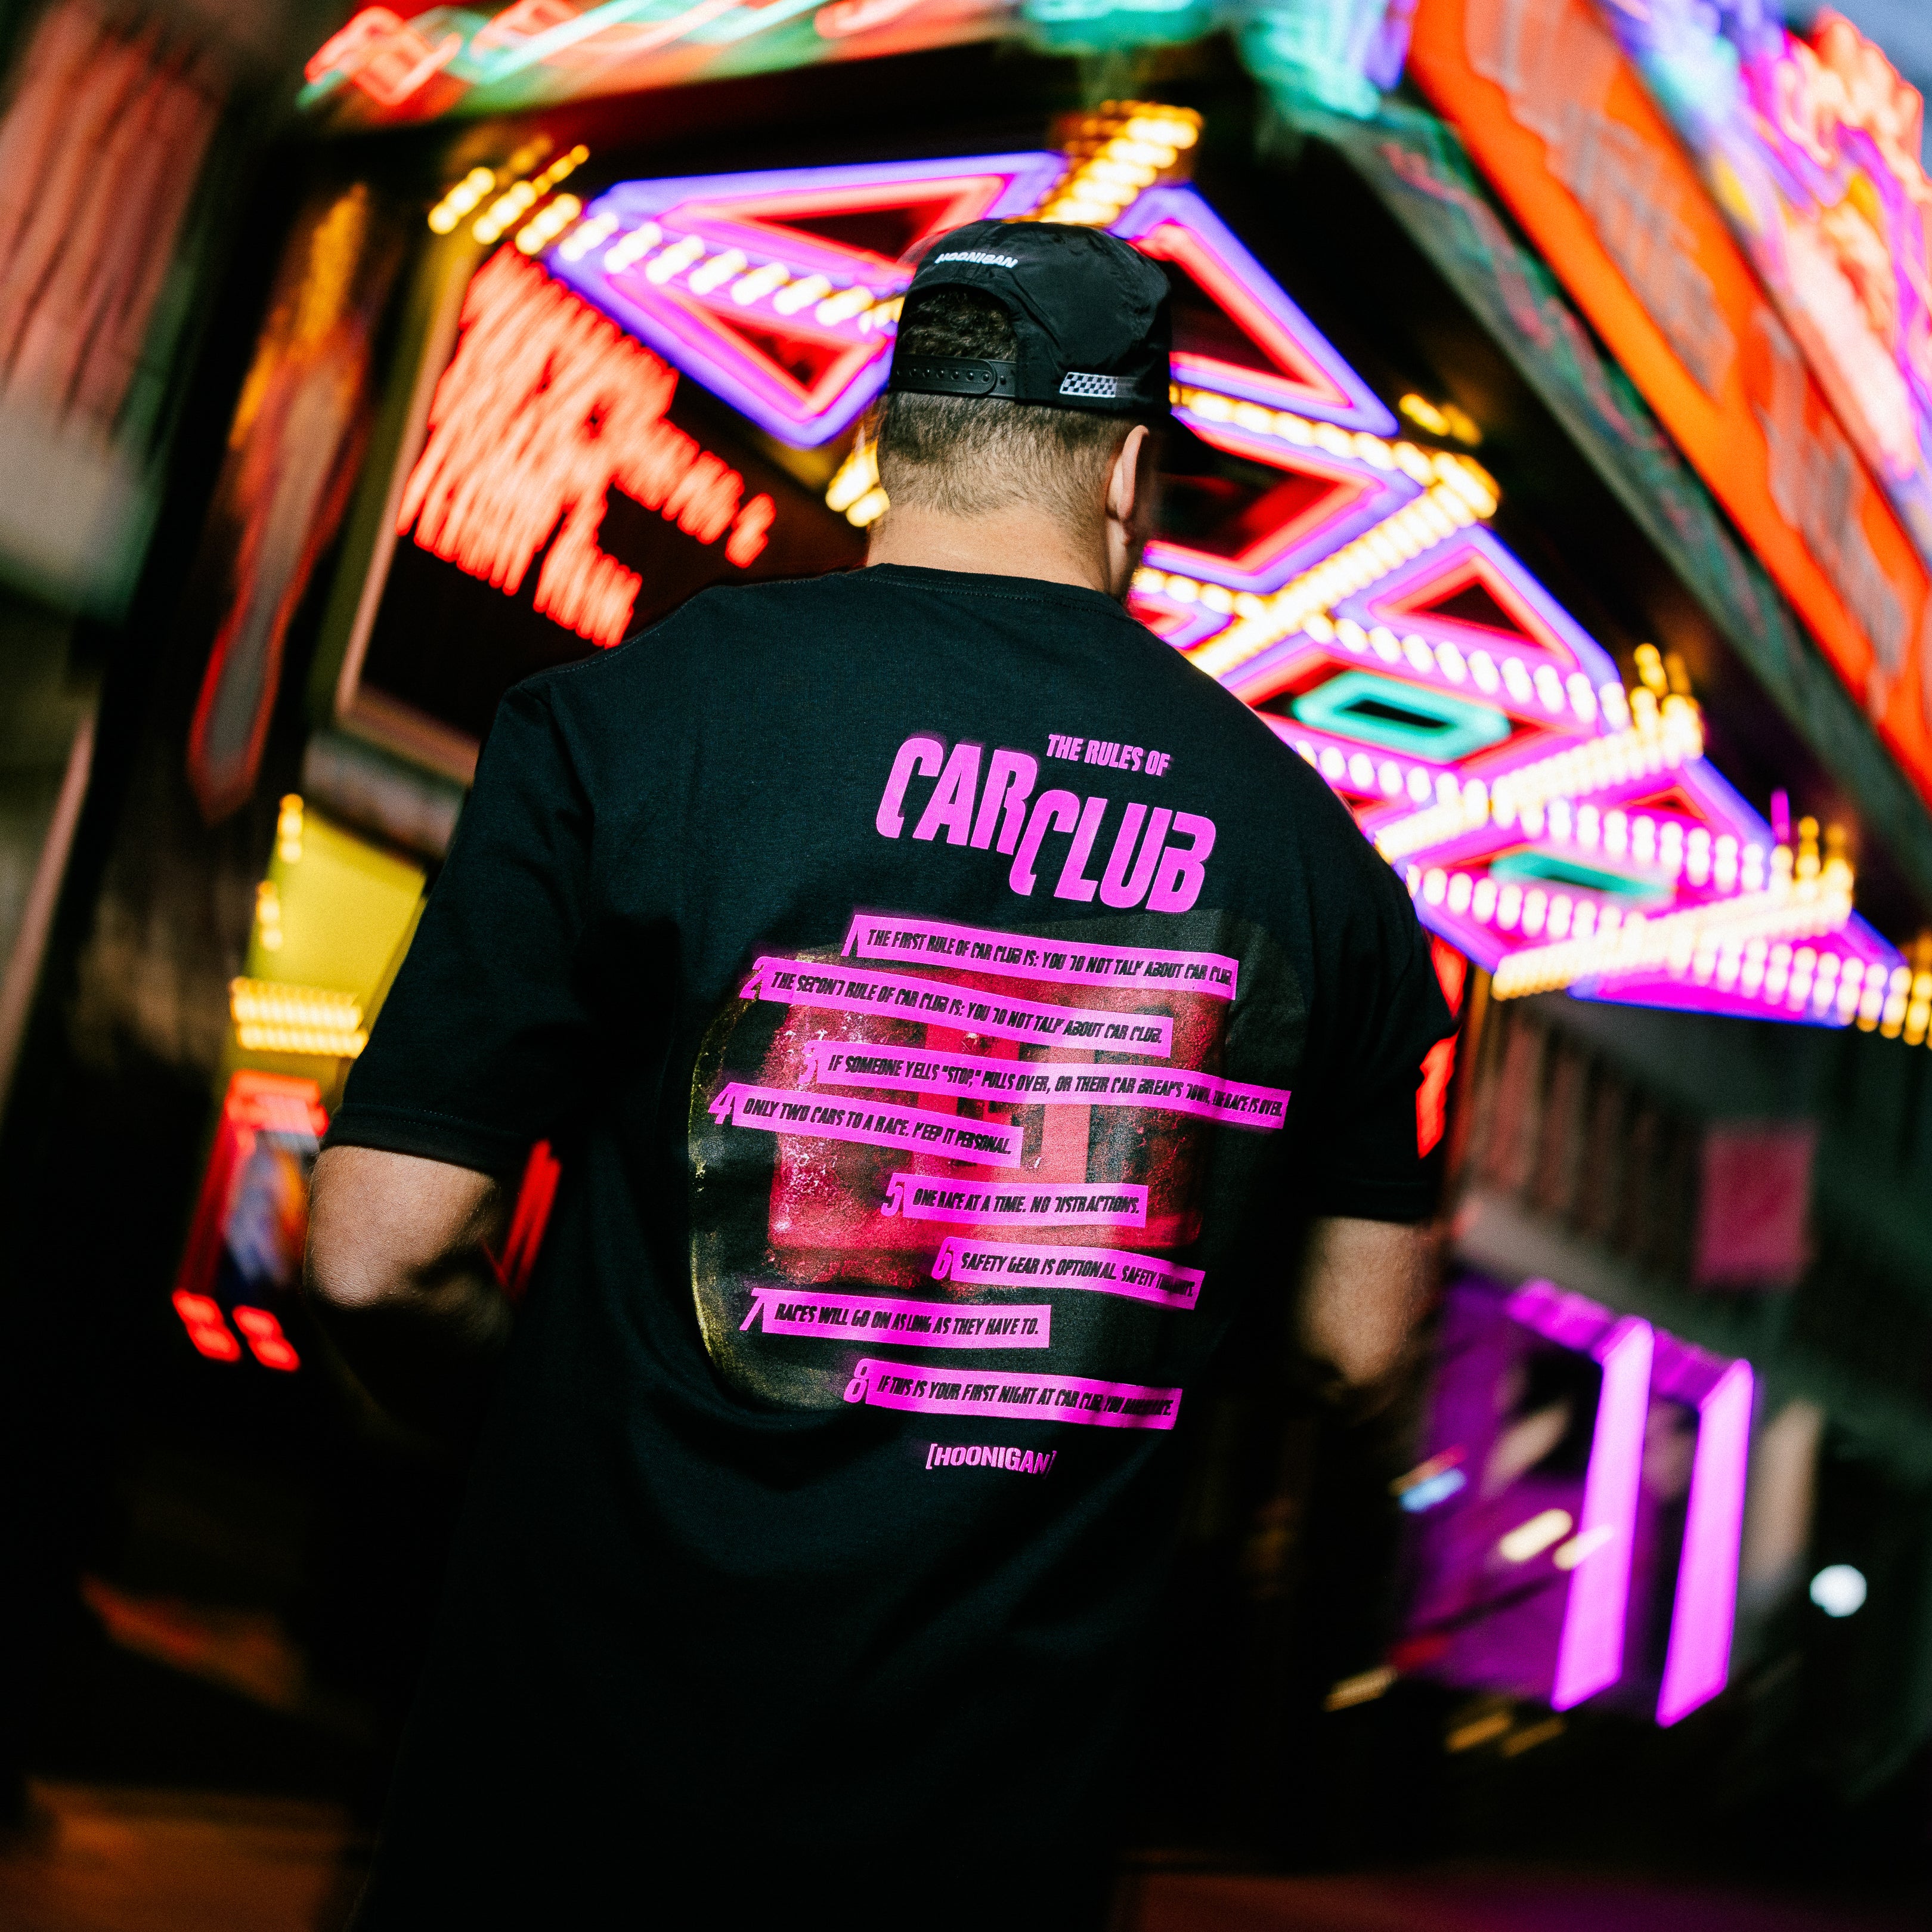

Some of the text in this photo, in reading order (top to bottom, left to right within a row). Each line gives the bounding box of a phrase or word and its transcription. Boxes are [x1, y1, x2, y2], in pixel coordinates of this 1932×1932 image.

[934, 252, 1018, 268] HOONIGAN
[1048, 733, 1171, 776] THE RULES OF
[876, 737, 1038, 855] CAR
[1009, 789, 1216, 914] CLUB
[867, 929, 891, 946] THE
[892, 931, 927, 950] FIRST
[927, 934, 956, 954] RULE
[955, 939, 971, 956] OF
[971, 942, 993, 960] CAR
[993, 945, 1022, 964] CLUB
[1023, 949, 1039, 967] IS:
[1042, 952, 1067, 970] YOU
[1085, 957, 1113, 974] NOT
[1113, 959, 1144, 976] TALK
[1143, 961, 1184, 978] ABOUT
[1184, 964, 1208, 980] CAR
[771, 971, 797, 989] THE
[844, 982, 878, 1000] RULE
[877, 986, 896, 1002] OF
[894, 988, 919, 1007] CAR
[919, 991, 949, 1014] CLUB
[949, 998, 965, 1016] IS:
[967, 1002, 991, 1021] YOU
[1007, 1011, 1034, 1029] NOT
[1032, 1015, 1064, 1033] TALK
[1063, 1020, 1104, 1038] ABOUT
[1104, 1023, 1129, 1039] CAR
[1129, 1026, 1163, 1044] CLUB.
[828, 1054, 844, 1071] IF
[845, 1055, 904, 1077] SOMEONE
[906, 1061, 940, 1080] YELLS
[982, 1070, 1015, 1090] PULLS
[1015, 1075, 1051, 1094] OVER,
[1054, 1075, 1073, 1092] OR
[1075, 1075, 1111, 1092] THEIR
[1110, 1076, 1136, 1093] CAR
[1225, 1092, 1250, 1112] RACE
[1249, 1096, 1260, 1113] IS
[743, 1098, 779, 1117] ONLY
[779, 1103, 811, 1121] TWO
[810, 1107, 846, 1126] CARS
[846, 1111, 864, 1128] TO
[865, 1114, 874, 1131] A
[874, 1116, 909, 1136] RACE.
[912, 1122, 943, 1141] KEEP
[942, 1128, 956, 1144] IT
[955, 1130, 1011, 1154] PERSONAL.
[912, 1188, 937, 1206] ONE
[937, 1190, 963, 1209] RACE
[963, 1194, 982, 1210] AT
[980, 1196, 991, 1212] A
[993, 1196, 1026, 1213] TIME.
[1030, 1196, 1051, 1213] NO
[960, 1252, 1008, 1272] SAFETY
[1007, 1256, 1041, 1274] GEAR
[1040, 1258, 1055, 1275] IS
[1120, 1265, 1158, 1287] SAFETY
[775, 1304, 818, 1323] RACES
[816, 1306, 848, 1326] WILL
[850, 1309, 870, 1328] GO
[871, 1311, 894, 1329] ON
[891, 1313, 907, 1331] AS
[905, 1314, 933, 1333] LONG
[932, 1316, 952, 1334] AS
[951, 1318, 986, 1335] THEY
[984, 1318, 1020, 1335] HAVE
[1018, 1318, 1039, 1335] TO.
[877, 1375, 891, 1392] IF
[889, 1376, 914, 1397] THIS
[912, 1380, 928, 1398] IS
[928, 1382, 962, 1400] YOUR
[961, 1383, 999, 1401] FIRST
[998, 1385, 1039, 1405] NIGHT
[1036, 1388, 1056, 1405] AT
[1054, 1389, 1080, 1408] CAR
